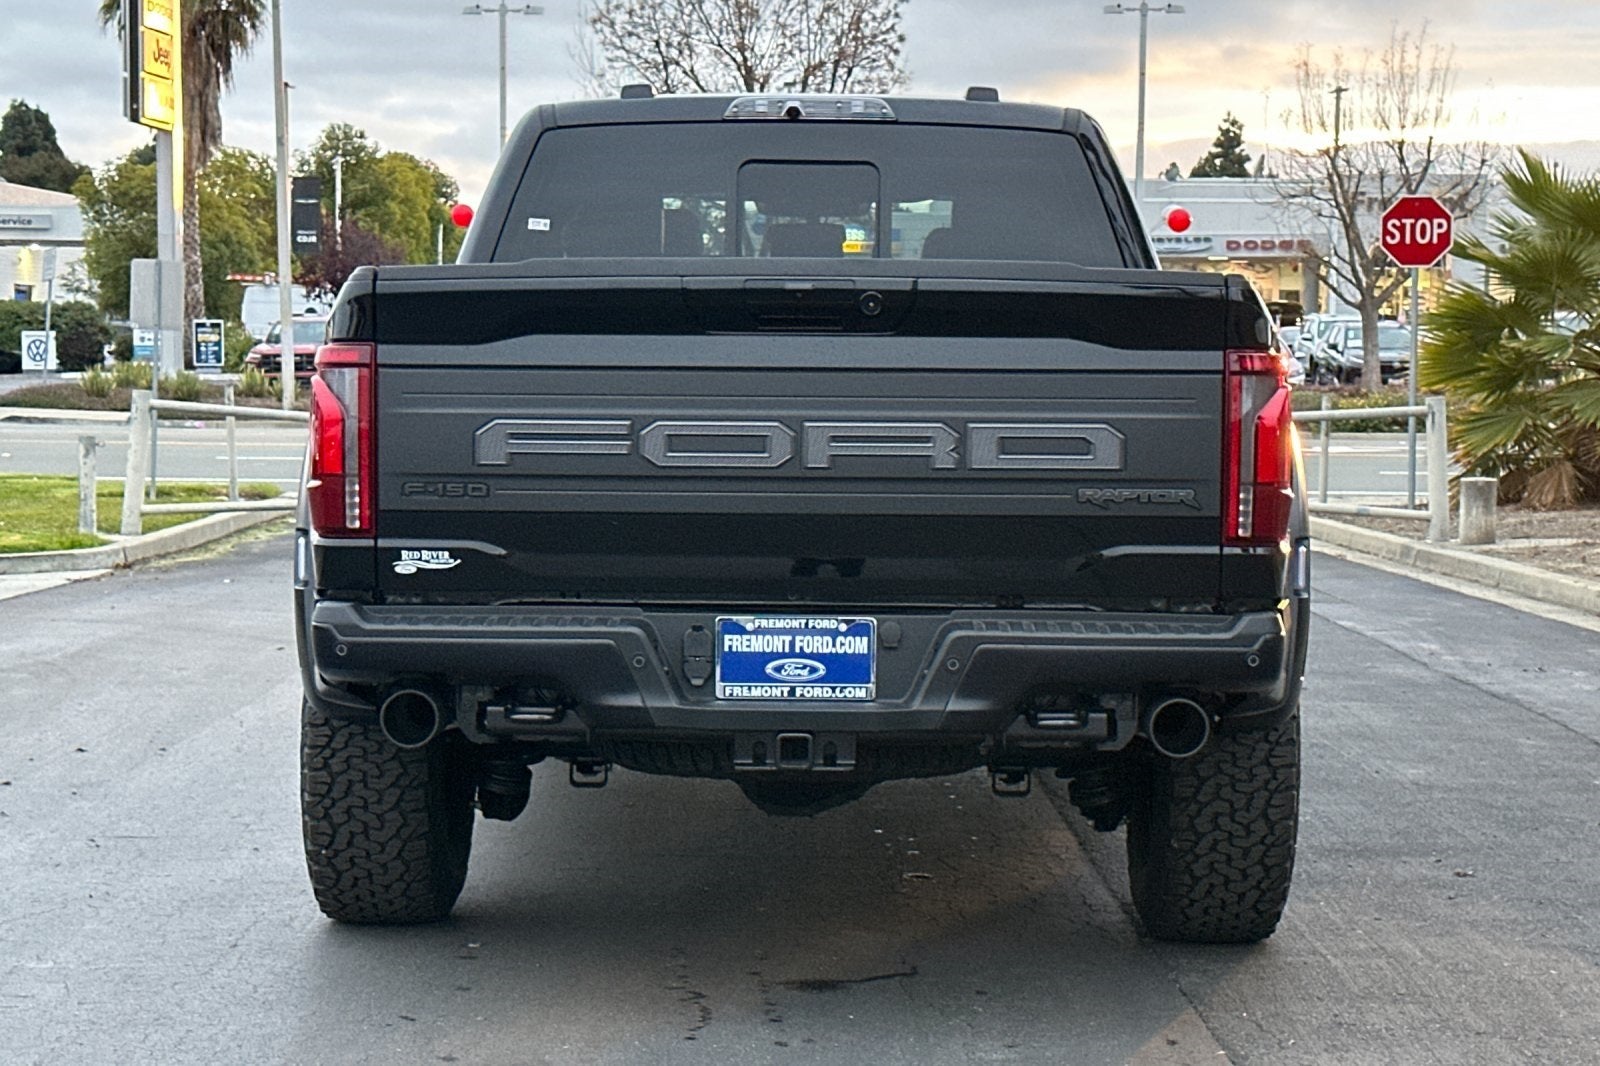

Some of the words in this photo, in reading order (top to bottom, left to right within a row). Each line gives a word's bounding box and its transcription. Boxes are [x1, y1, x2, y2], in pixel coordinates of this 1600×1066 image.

[1385, 218, 1448, 245] STOP
[1226, 239, 1312, 251] DODGE
[473, 418, 1126, 470] FORD
[402, 482, 490, 497] F-150
[1077, 488, 1202, 511] RAPTOR
[401, 550, 420, 561] RED
[421, 550, 450, 561] RIVER
[754, 619, 808, 629] FREMONT
[809, 619, 838, 629] FORD
[723, 634, 792, 653] FREMONT
[795, 635, 869, 654] FORD.COM
[781, 662, 811, 677] Ford
[725, 686, 791, 697] FREMONT
[795, 686, 867, 698] FORD.COM
